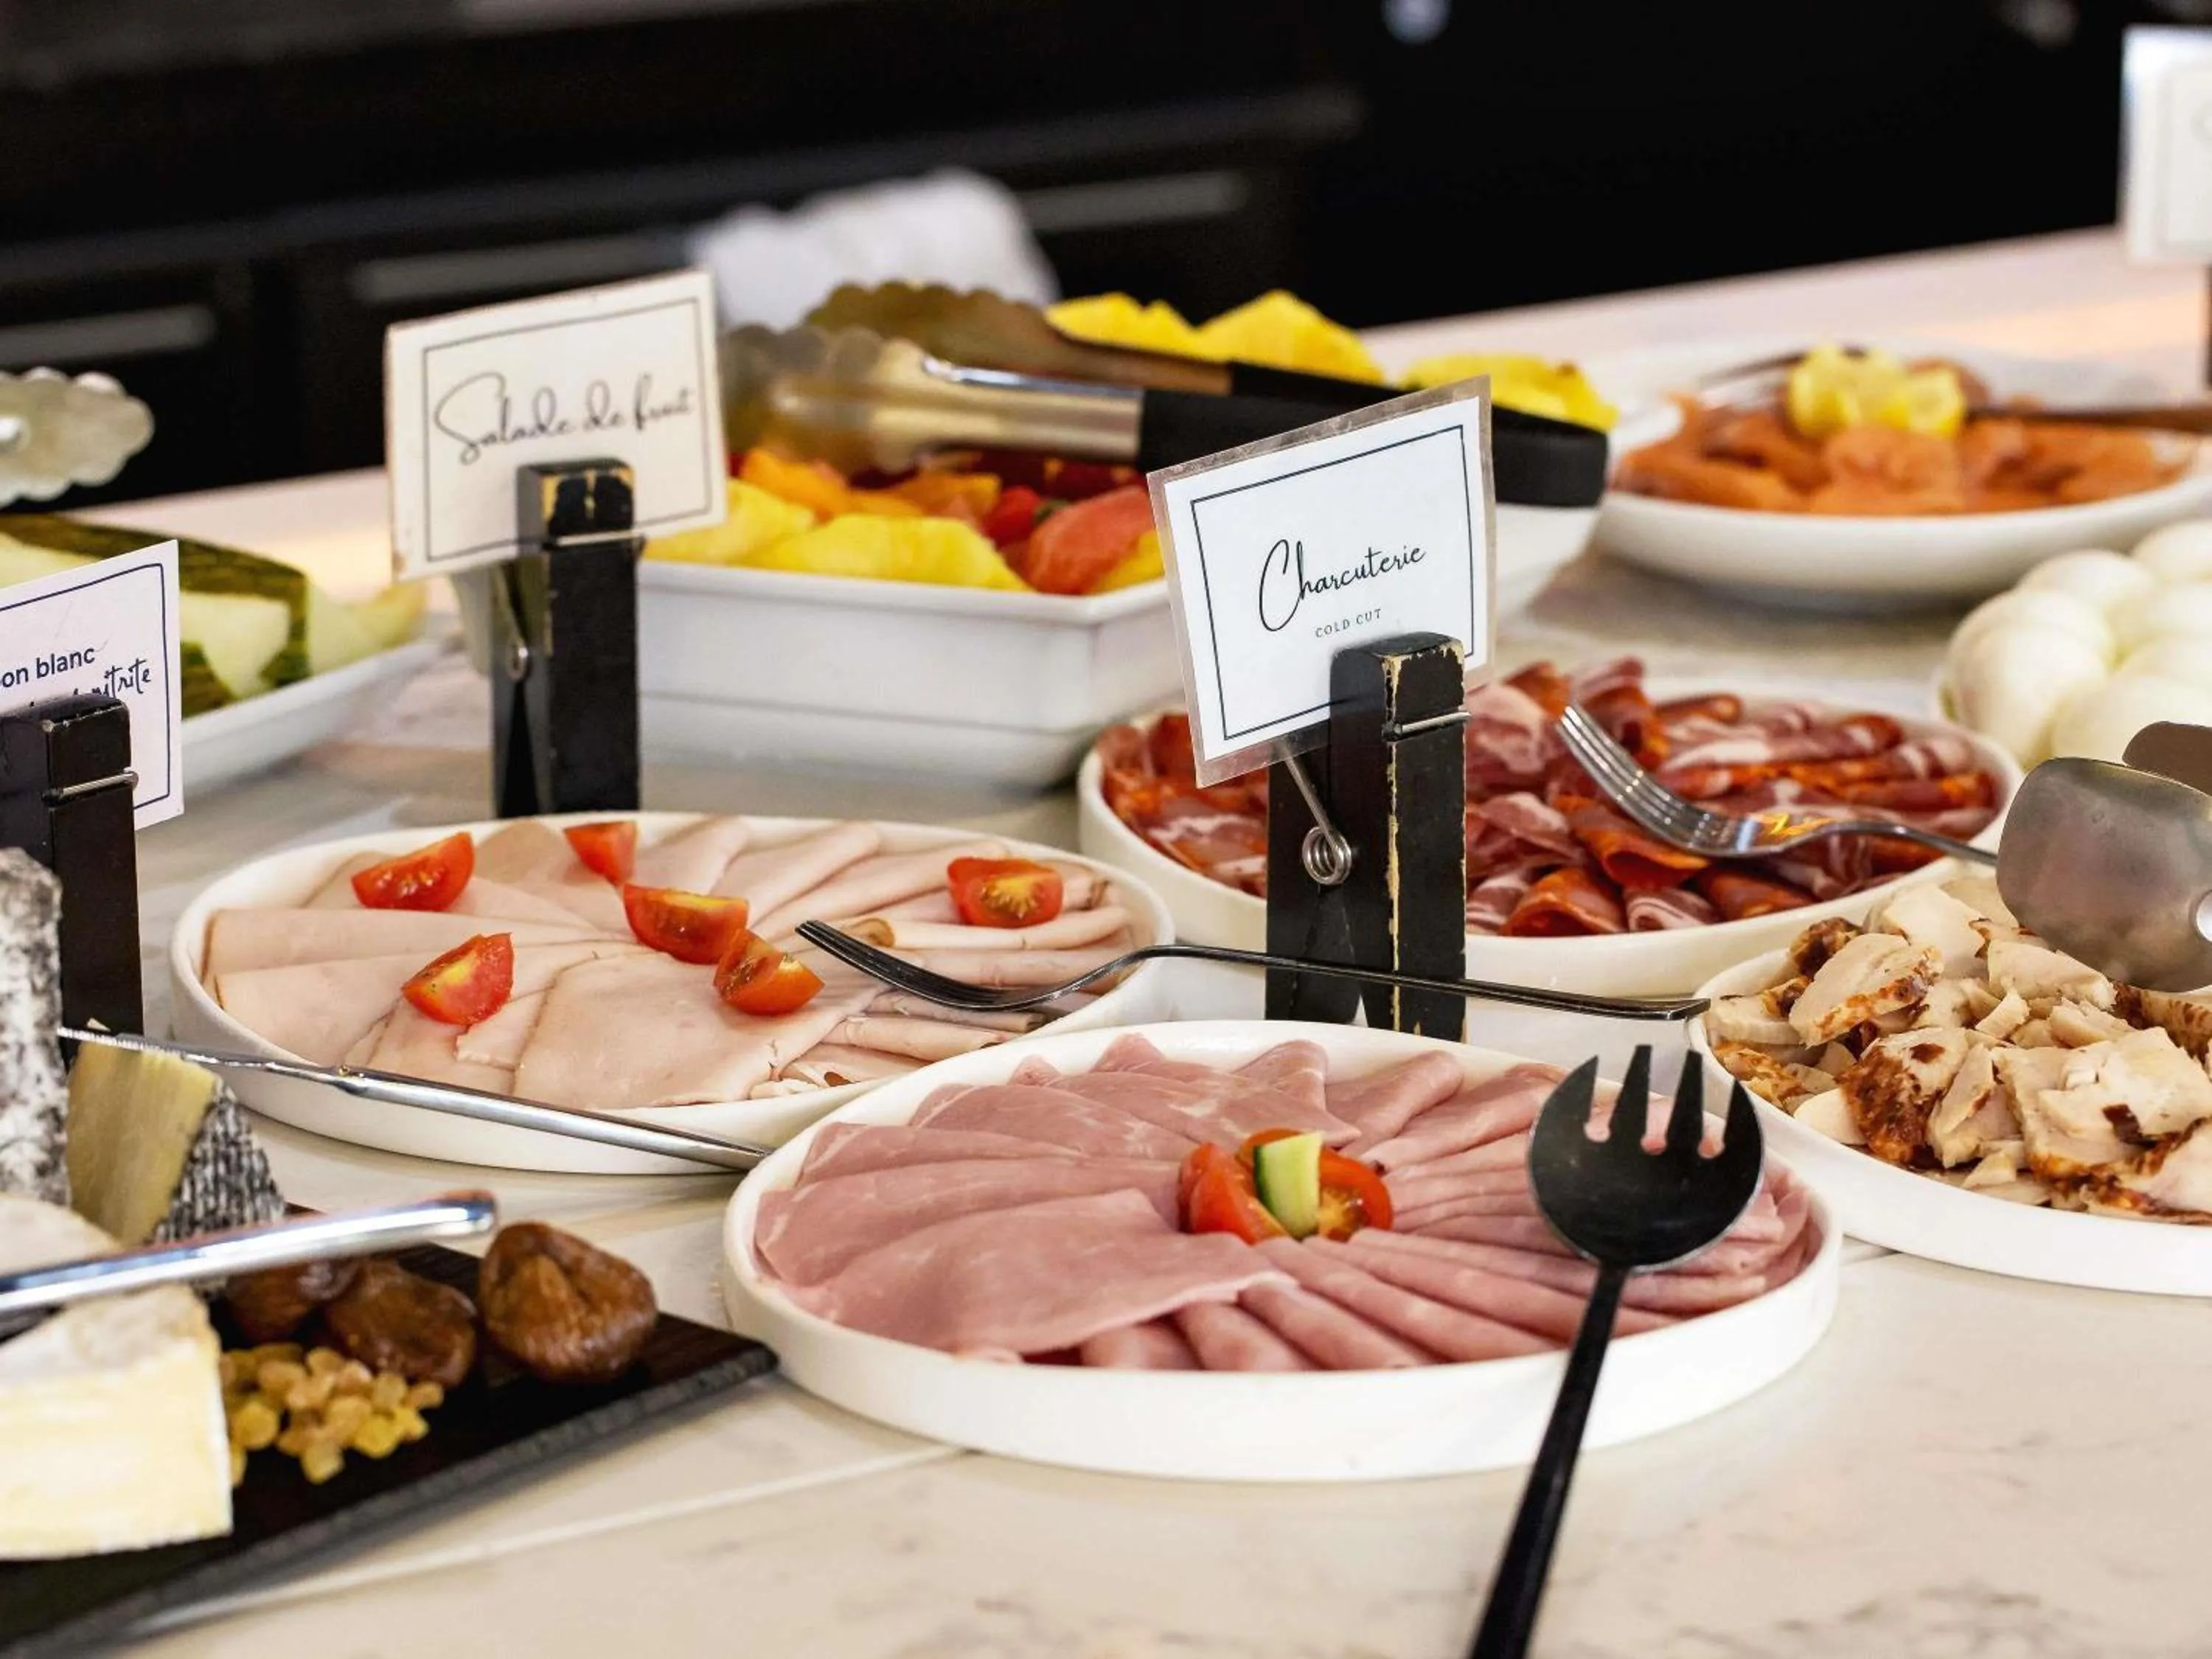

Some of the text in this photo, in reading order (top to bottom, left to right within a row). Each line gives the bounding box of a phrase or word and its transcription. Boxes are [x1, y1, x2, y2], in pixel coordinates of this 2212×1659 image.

[433, 371, 574, 466] Salade
[582, 379, 626, 431] de
[1259, 539, 1426, 631] Charcuterie
[1315, 608, 1381, 639] COLD CUT
[0, 647, 95, 688] on blanc
